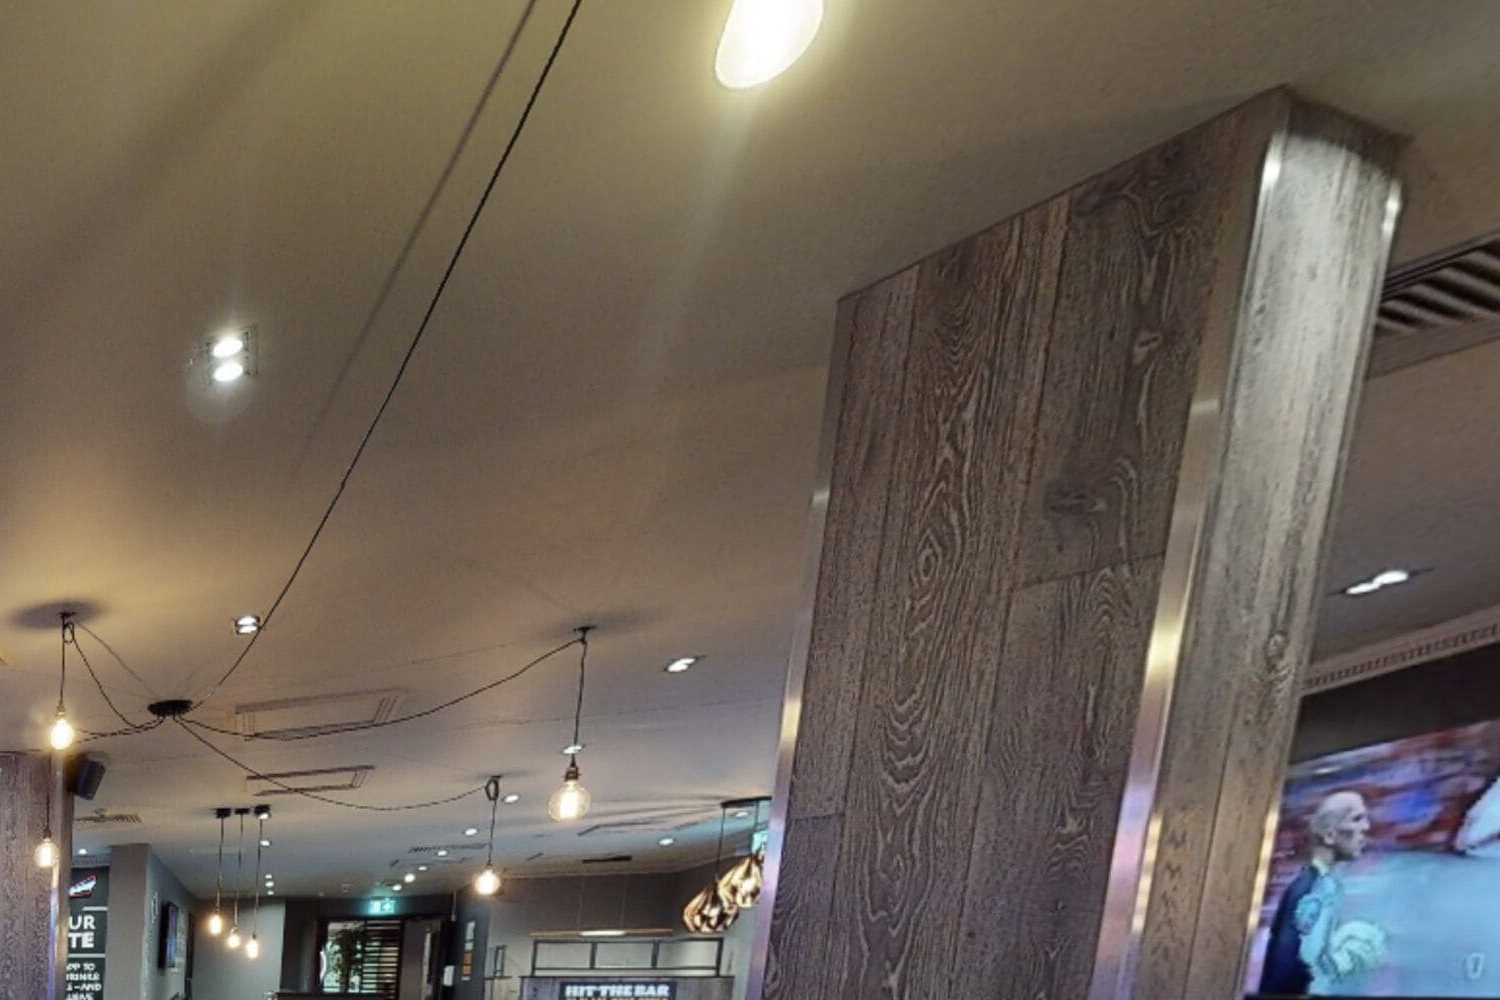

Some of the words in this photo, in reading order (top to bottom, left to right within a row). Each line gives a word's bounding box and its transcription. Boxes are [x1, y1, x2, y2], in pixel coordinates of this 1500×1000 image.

[68, 914, 96, 930] UR
[67, 931, 95, 949] TE
[565, 985, 596, 997] HIT
[597, 985, 632, 997] THE
[634, 984, 669, 997] BAR
